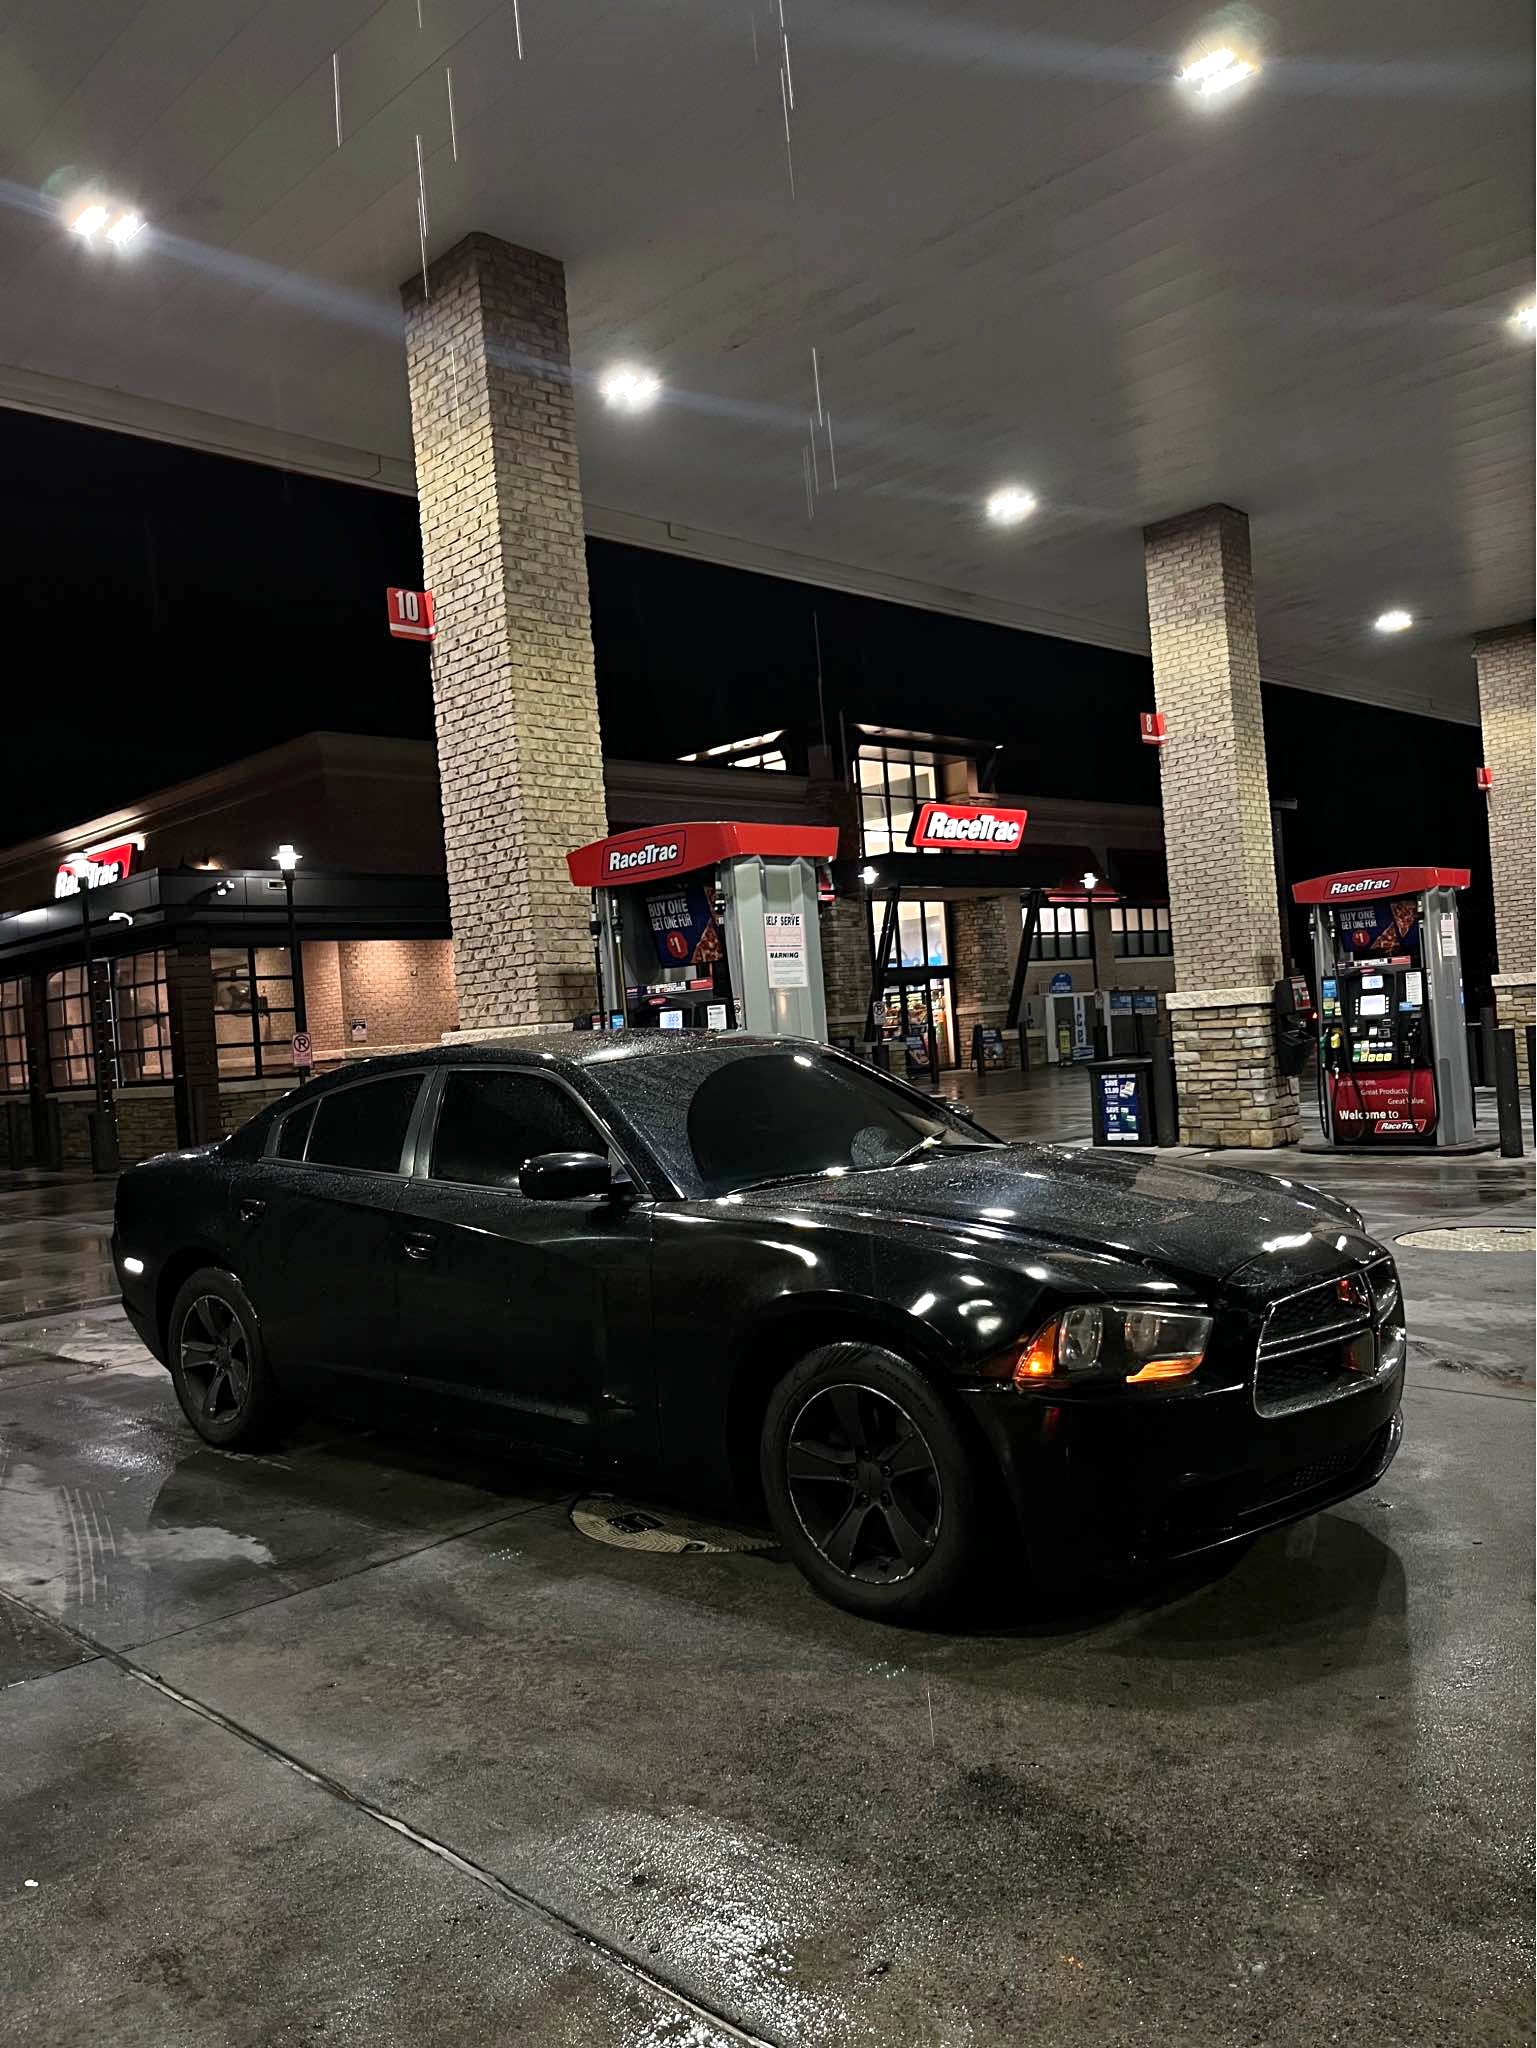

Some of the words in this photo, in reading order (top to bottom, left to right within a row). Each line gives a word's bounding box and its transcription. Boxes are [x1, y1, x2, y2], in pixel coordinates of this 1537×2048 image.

[395, 590, 419, 622] 10
[1146, 714, 1152, 733] 8
[927, 811, 1020, 842] RaceTrac
[609, 844, 678, 871] RaceTrac
[55, 862, 119, 899] RacTrac
[1330, 879, 1391, 895] RaceTrac
[648, 901, 666, 918] BUY
[667, 898, 689, 914] ONE
[651, 917, 664, 931] GET
[663, 914, 679, 930] ONE
[677, 912, 693, 928] FOR
[780, 915, 801, 926] SERVE
[770, 951, 799, 959] WARNING
[1388, 1110, 1399, 1120] to
